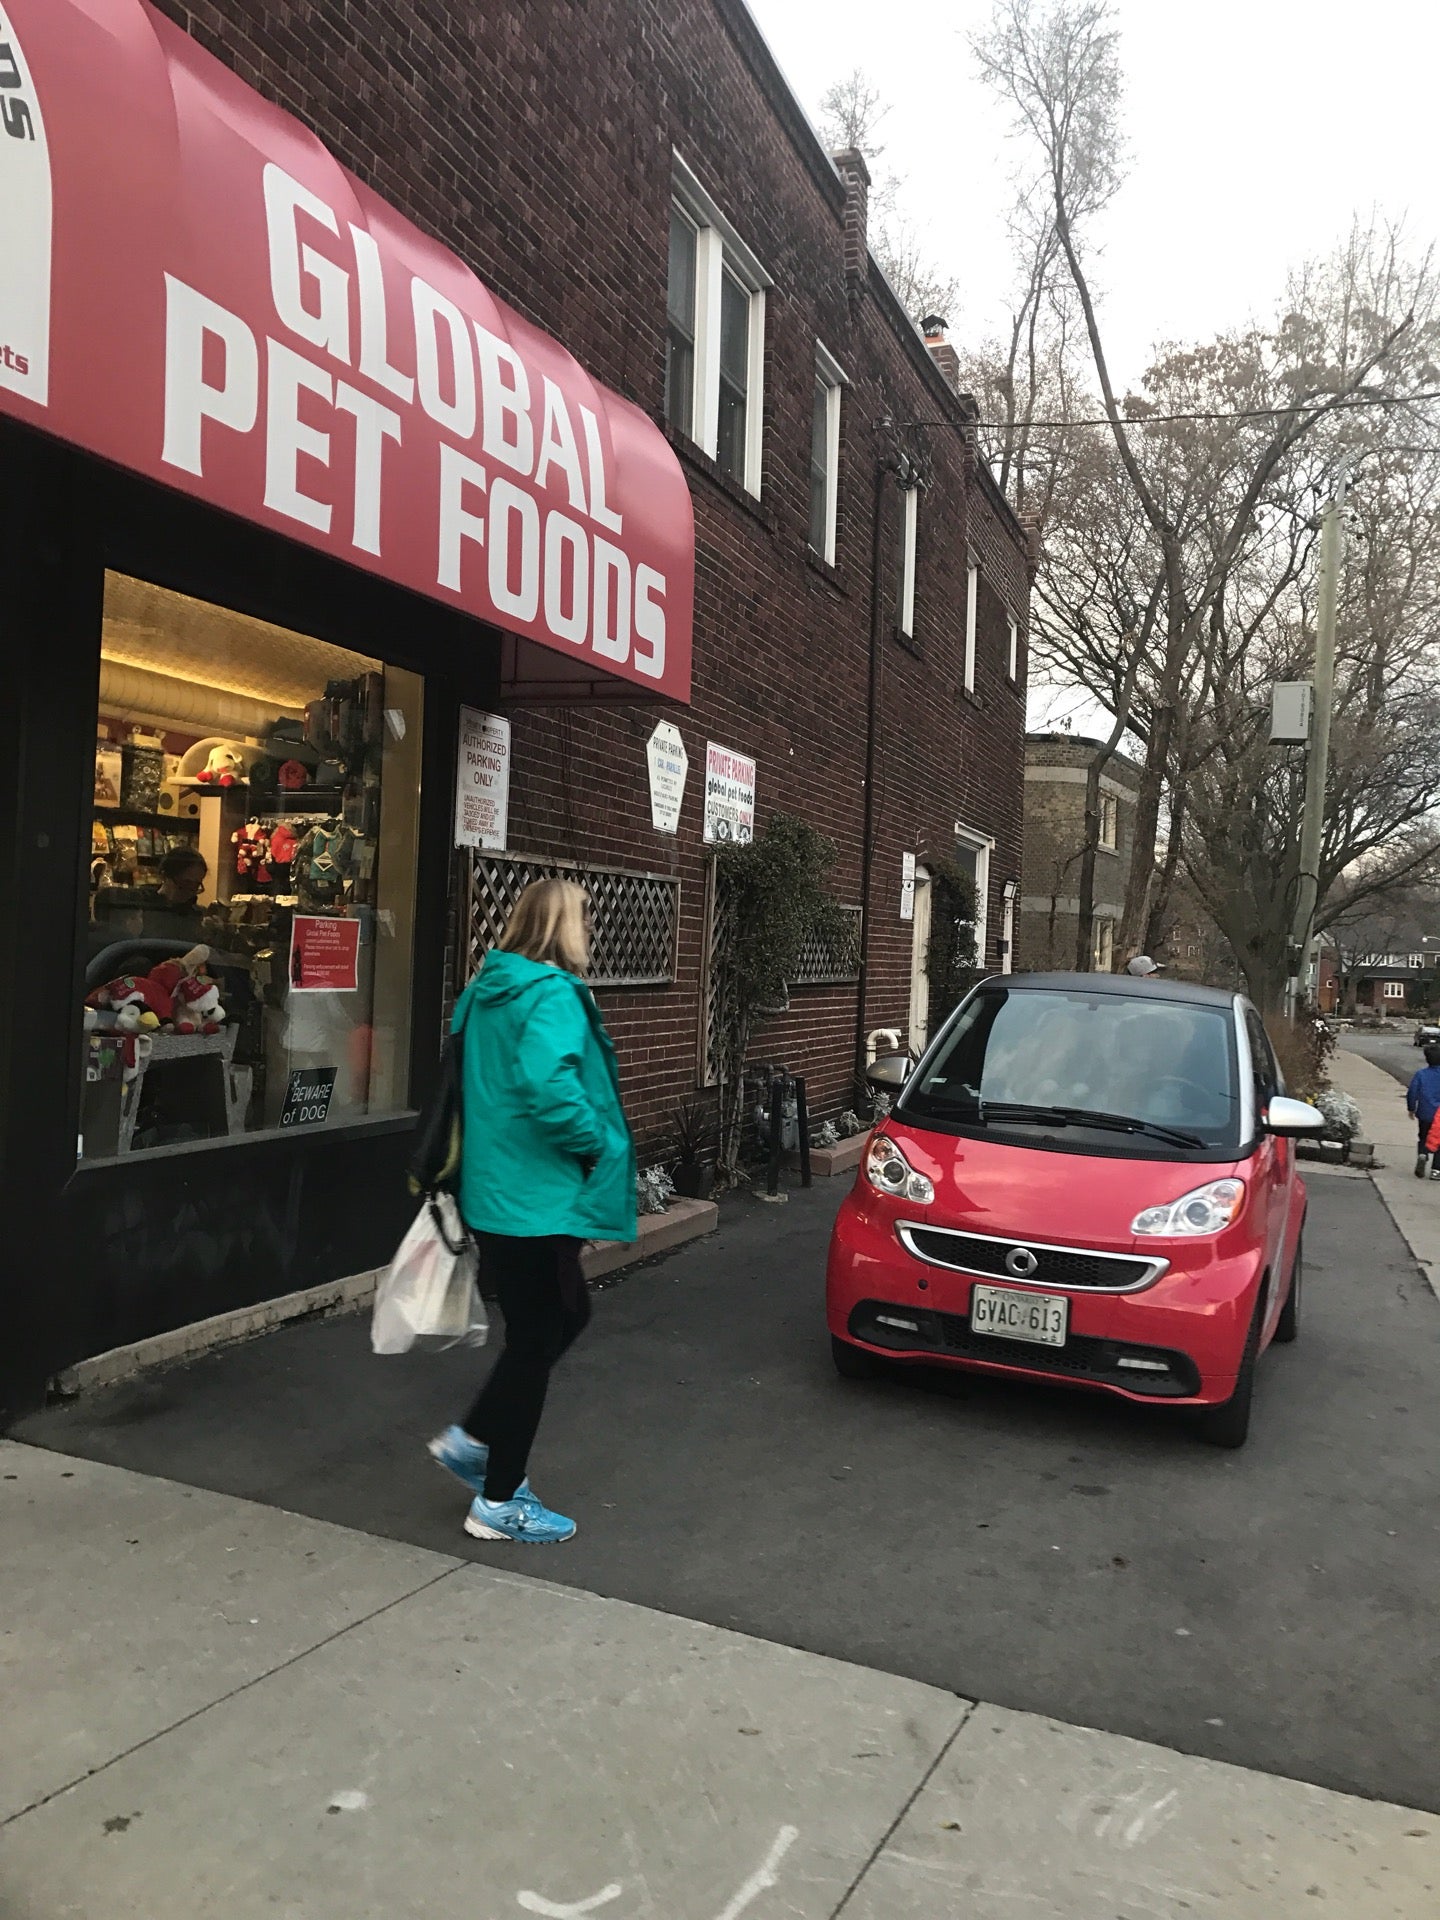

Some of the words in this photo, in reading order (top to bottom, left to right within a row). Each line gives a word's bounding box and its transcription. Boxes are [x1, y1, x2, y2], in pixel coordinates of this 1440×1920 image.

[0, 344, 29, 375] ts
[263, 162, 622, 535] GLOBAL
[161, 271, 401, 557] PET
[437, 441, 667, 680] FOODS
[462, 733, 507, 756] AUTHORIZED
[466, 751, 501, 772] PARKING
[708, 749, 731, 779] PRIVATE
[731, 759, 754, 788] PARKING
[473, 771, 494, 788] ONLY
[708, 777, 727, 796] global
[727, 786, 738, 802] pet
[738, 788, 753, 806] foods
[707, 800, 739, 822] CUSTOMERS
[314, 920, 337, 931] Parking
[291, 1083, 333, 1103] BEWARE
[282, 1108, 297, 1124] of
[299, 1104, 327, 1122] DOG
[976, 1298, 1018, 1326] GVAC
[1029, 1306, 1062, 1334] 613
